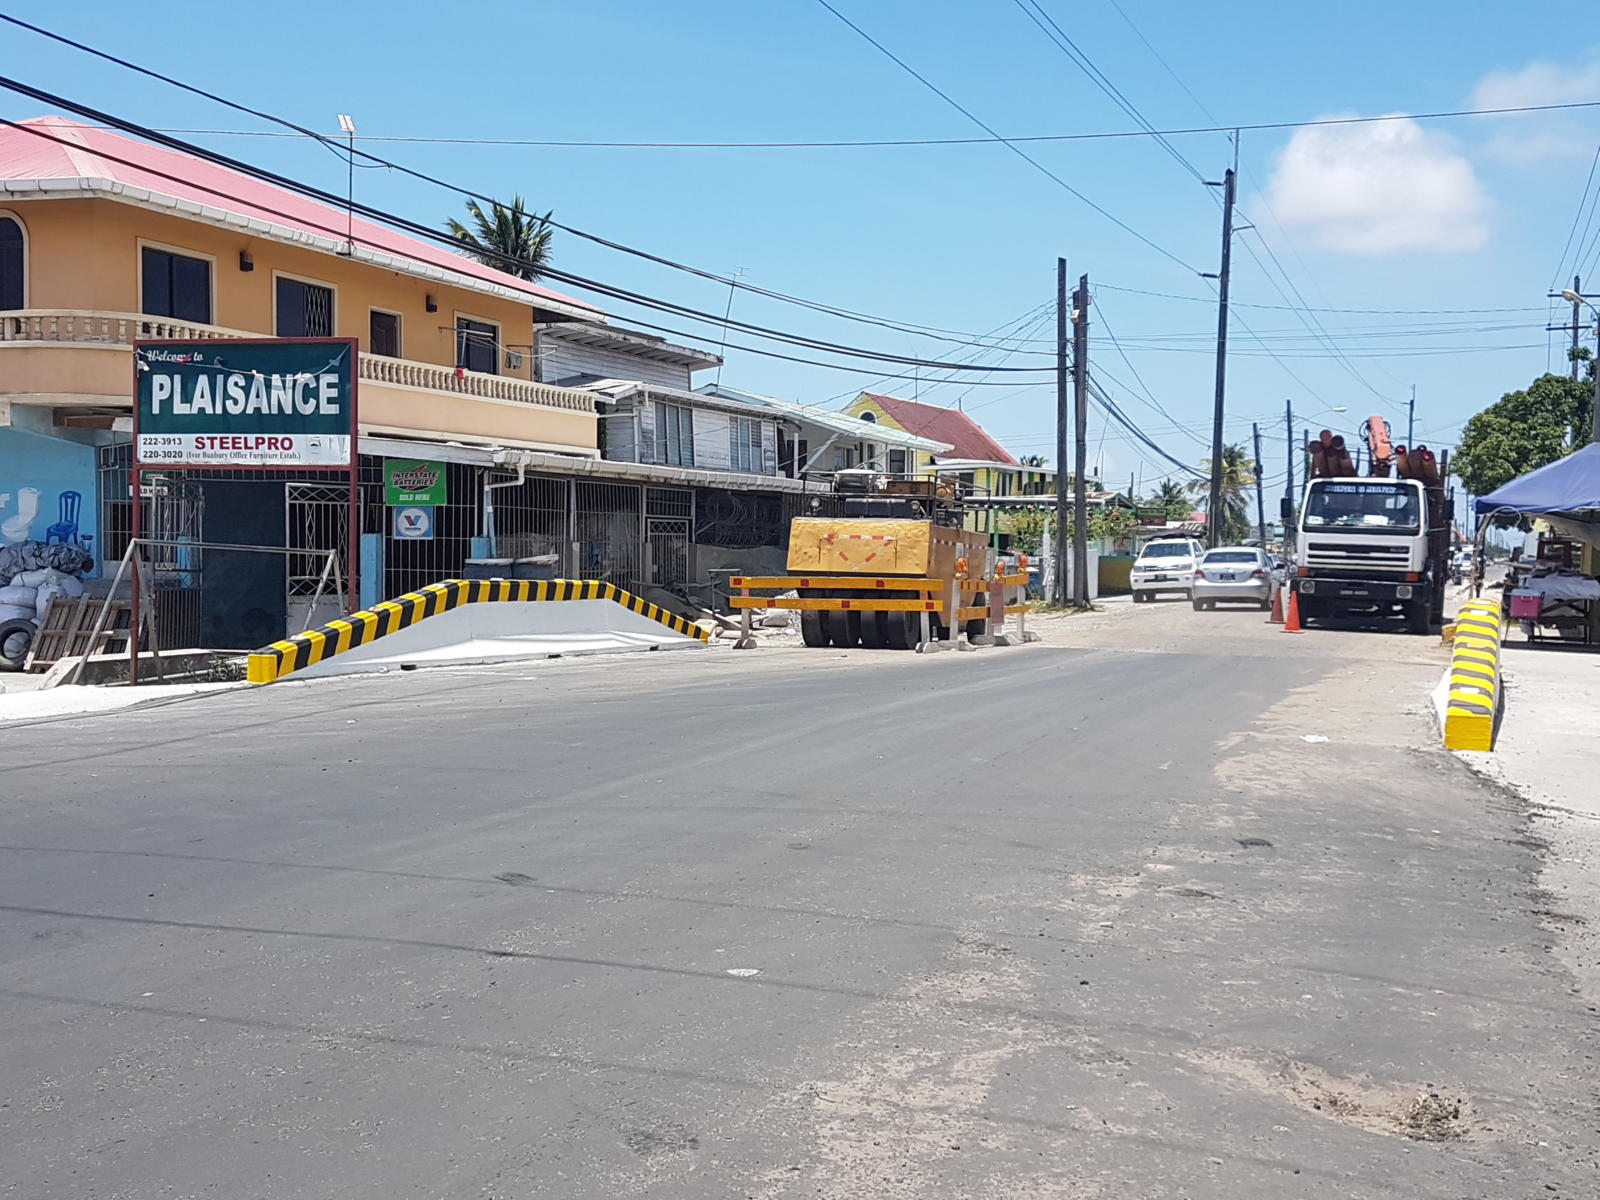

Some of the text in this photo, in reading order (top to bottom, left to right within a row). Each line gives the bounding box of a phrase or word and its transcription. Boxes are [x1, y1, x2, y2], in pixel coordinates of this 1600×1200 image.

[147, 350, 203, 362] Welcom to
[152, 373, 340, 415] PLAISANCE
[143, 437, 182, 446] 222-3913
[195, 436, 294, 451] STEELPRO
[143, 450, 183, 459] 220-3020
[229, 452, 248, 460] Office
[249, 452, 279, 460] Furniture
[279, 452, 301, 460] Estab.)
[393, 471, 439, 479] INTERSTATE
[393, 479, 435, 487] BATTERIES
